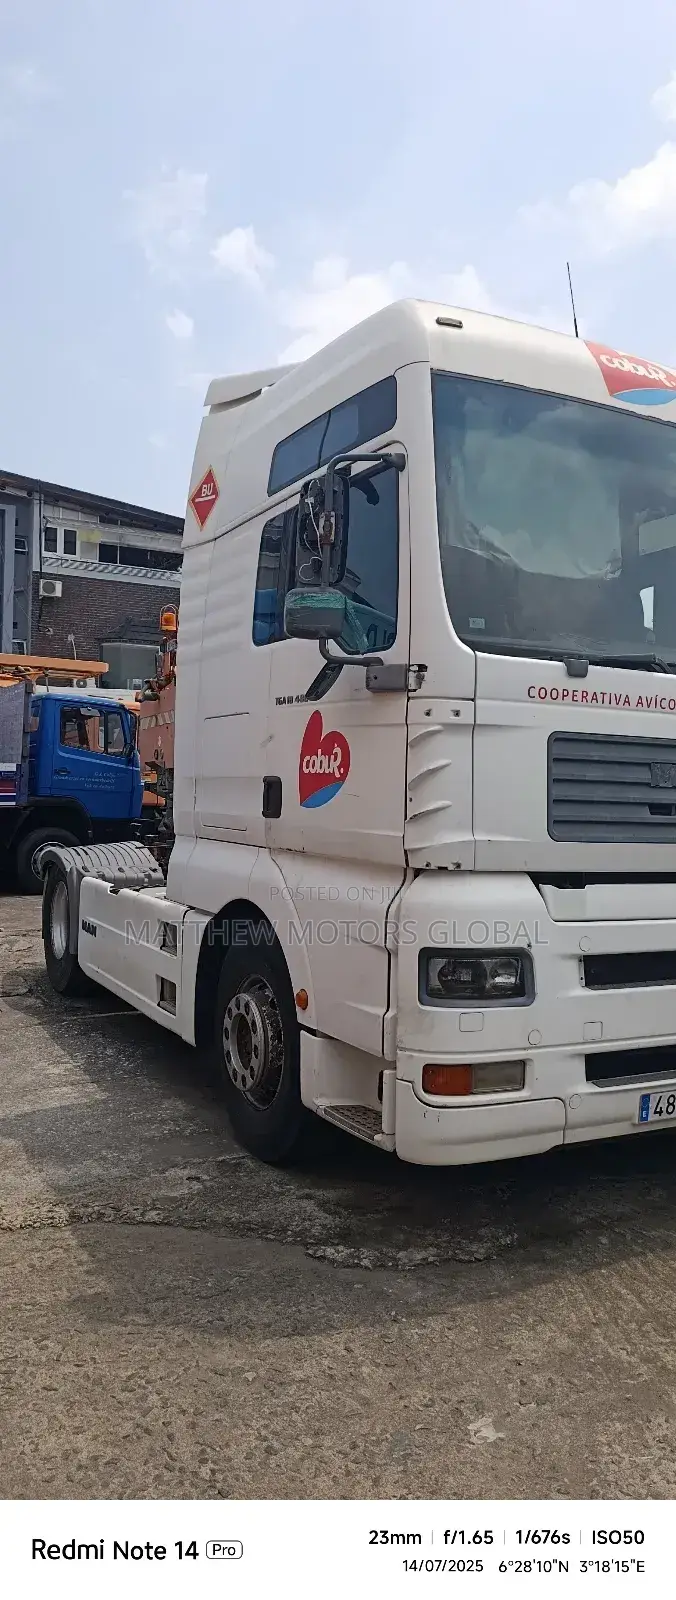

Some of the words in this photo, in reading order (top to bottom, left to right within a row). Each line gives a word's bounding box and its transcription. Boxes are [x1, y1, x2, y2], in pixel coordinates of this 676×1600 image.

[201, 483, 213, 496] BU
[527, 686, 631, 707] COOPERATIVA
[636, 695, 676, 710] AVÍCO
[82, 919, 97, 938] MAN
[653, 1094, 676, 1117] 48
